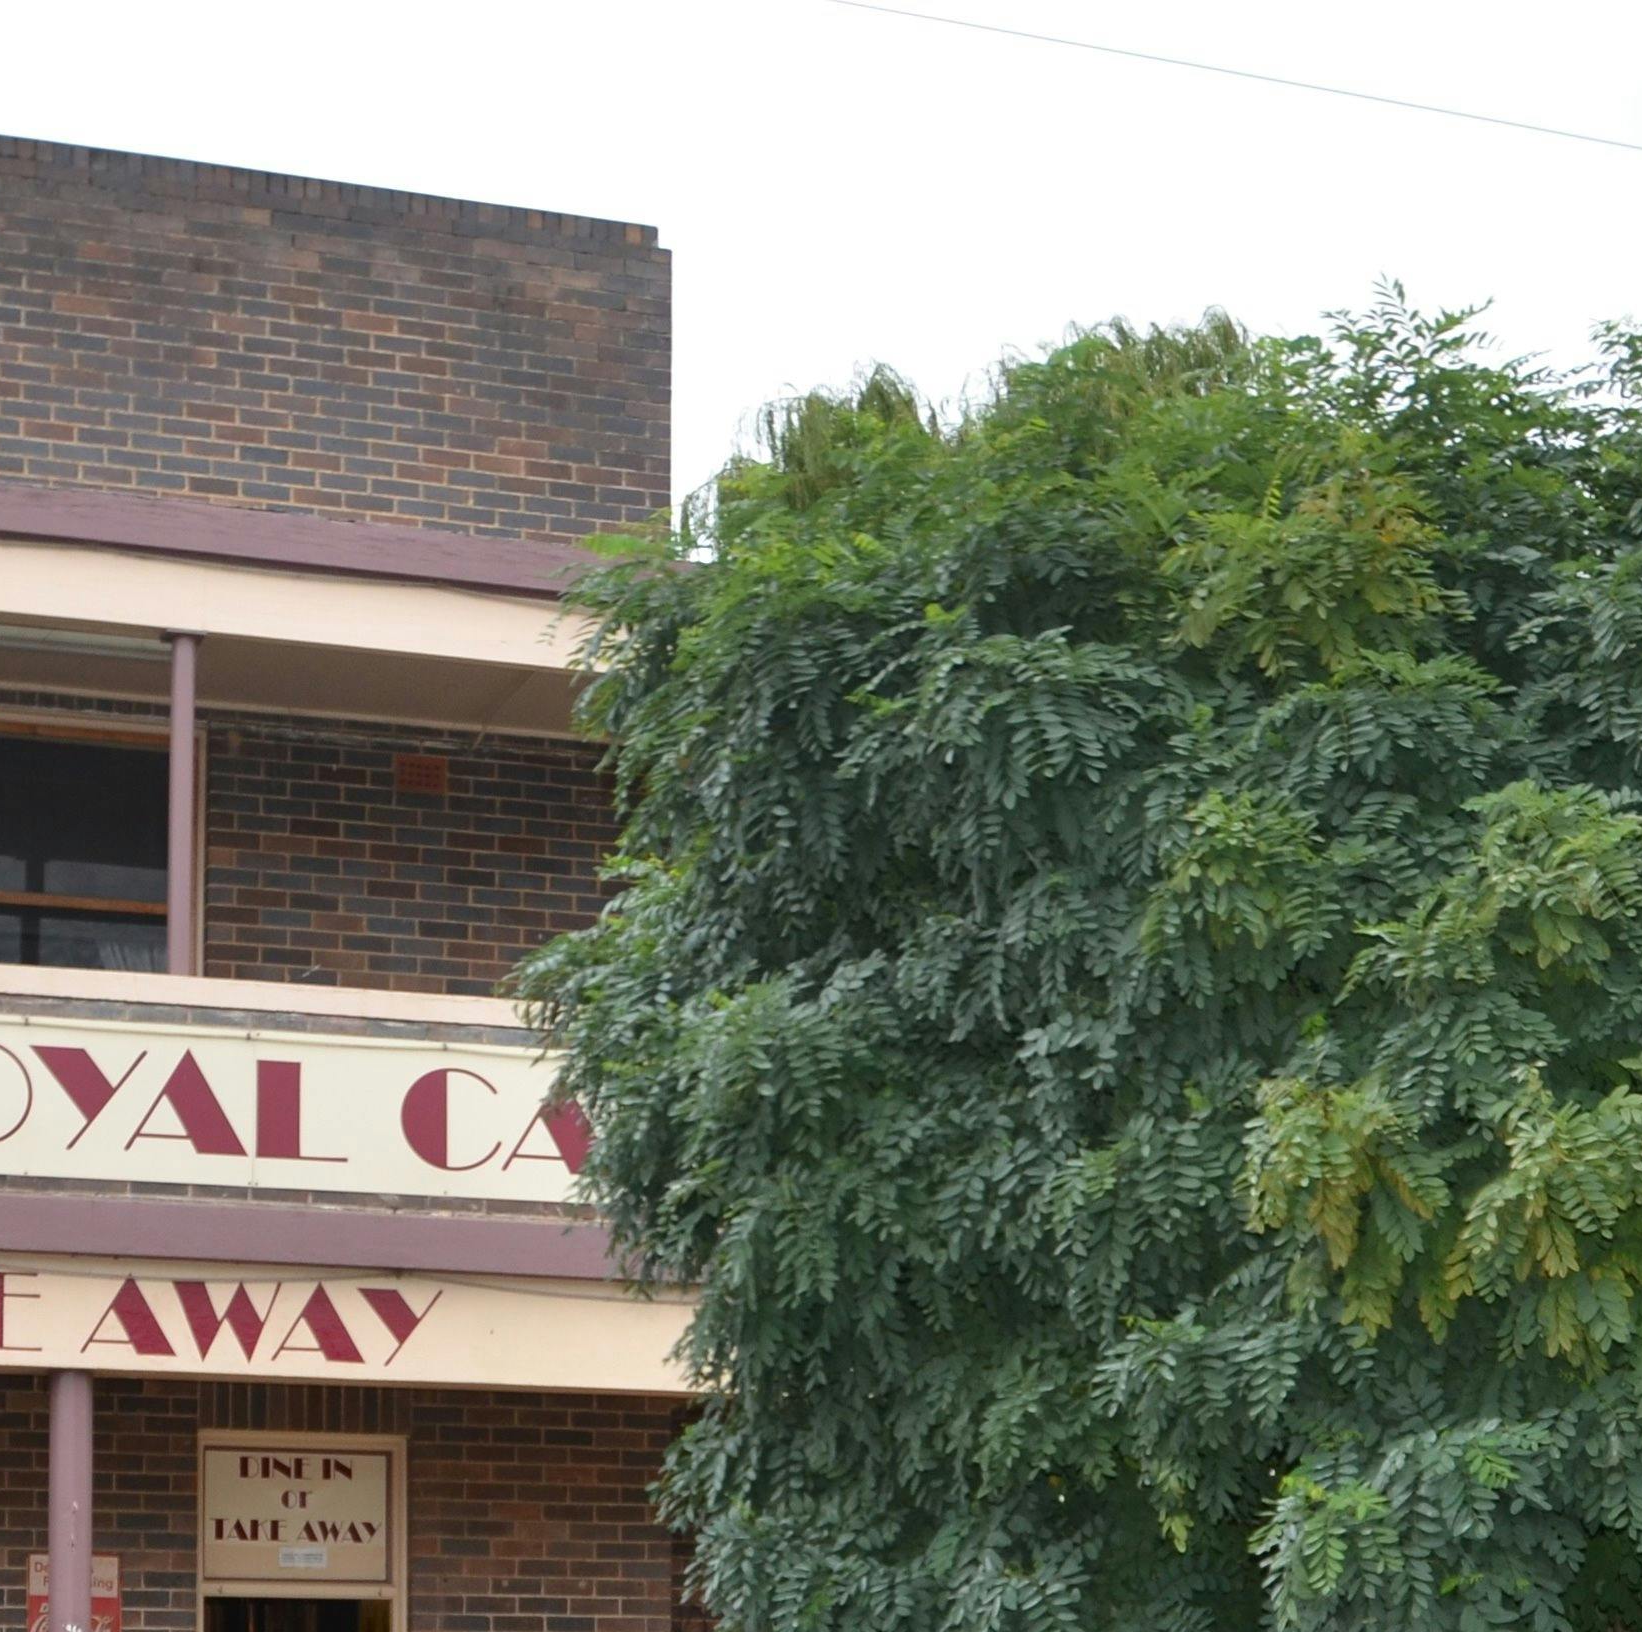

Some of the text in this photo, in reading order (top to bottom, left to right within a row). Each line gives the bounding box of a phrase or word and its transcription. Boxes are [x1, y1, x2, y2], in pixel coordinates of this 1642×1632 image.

[400, 1066, 600, 1176] CA
[80, 1274, 444, 1368] AWAY
[239, 1455, 353, 1481] DINE IN
[280, 1489, 314, 1510] or
[210, 1517, 382, 1544] TAKE AWAY
